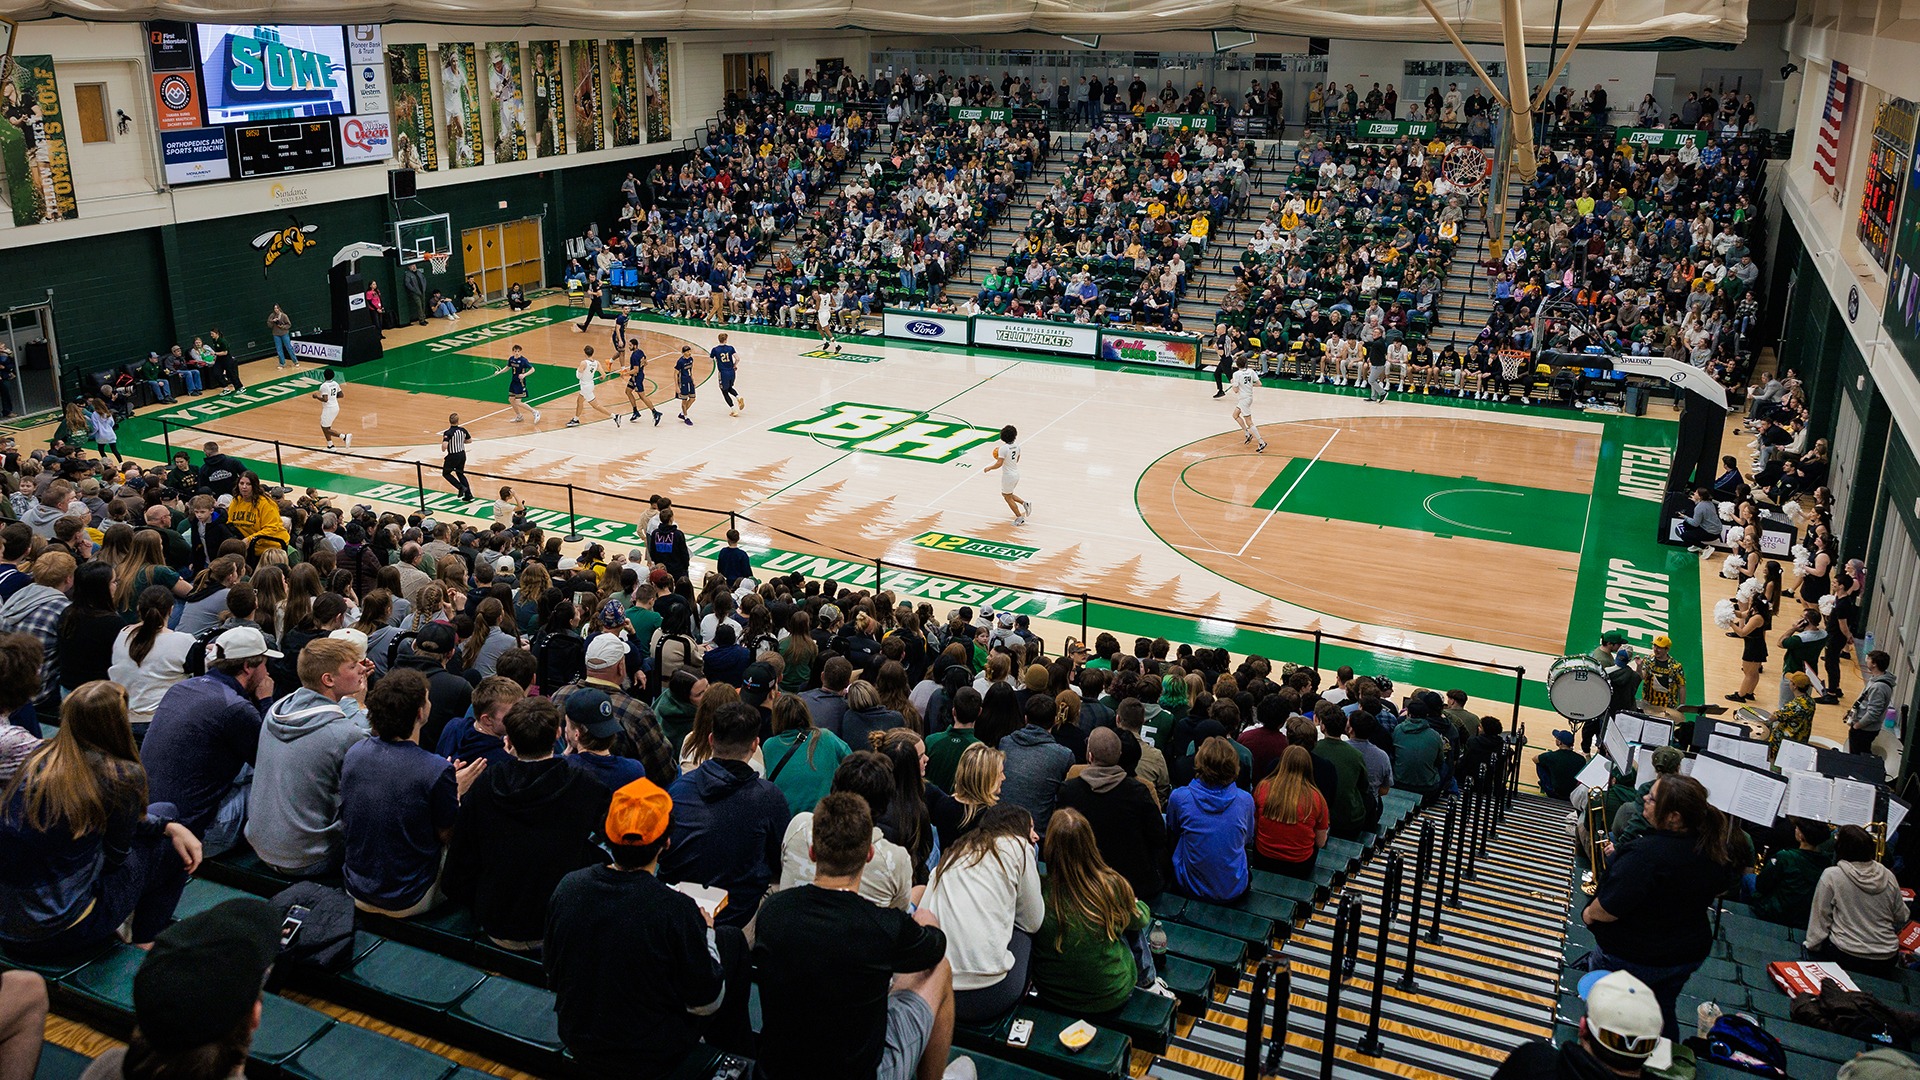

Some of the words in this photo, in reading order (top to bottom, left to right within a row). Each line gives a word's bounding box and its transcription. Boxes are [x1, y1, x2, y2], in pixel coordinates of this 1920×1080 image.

[231, 35, 338, 91] SOME
[417, 48, 429, 80] RODEO
[548, 75, 557, 112] JACKET
[625, 47, 639, 139] TRIATHLON
[555, 84, 564, 120] TRACK
[990, 110, 1005, 120] 102
[1157, 117, 1168, 126] A2
[1191, 118, 1208, 128] 103
[1371, 124, 1382, 133] A2
[1408, 125, 1427, 135] 104
[344, 119, 389, 153] Queen
[1631, 133, 1646, 142] A2
[166, 139, 210, 149] ORTHOPEDICS
[166, 146, 193, 156] SPORTS
[193, 144, 224, 154] MEDICINE
[43, 121, 76, 214] WOMEN'S
[275, 186, 308, 198] Sundance
[912, 321, 937, 336] Ford
[996, 330, 1033, 344] YELLOW
[1031, 333, 1073, 347] JACKETS
[301, 344, 328, 357] DANA
[720, 352, 730, 363] 21
[1120, 348, 1157, 362] SIGNS
[158, 376, 323, 421] YELLOW
[425, 315, 553, 352] JACKETS
[1621, 357, 1652, 365] SPALDING
[330, 387, 336, 396] 12
[776, 403, 1000, 462] BH
[1011, 450, 1016, 460] 2
[1617, 443, 1672, 504] YELLOW
[912, 533, 969, 550] A2
[961, 542, 1034, 560] ARENA
[1761, 535, 1786, 545] ENTAL
[1761, 542, 1777, 550] RTS
[354, 483, 496, 516] BLACK
[761, 551, 1083, 620] UNIVERSITY
